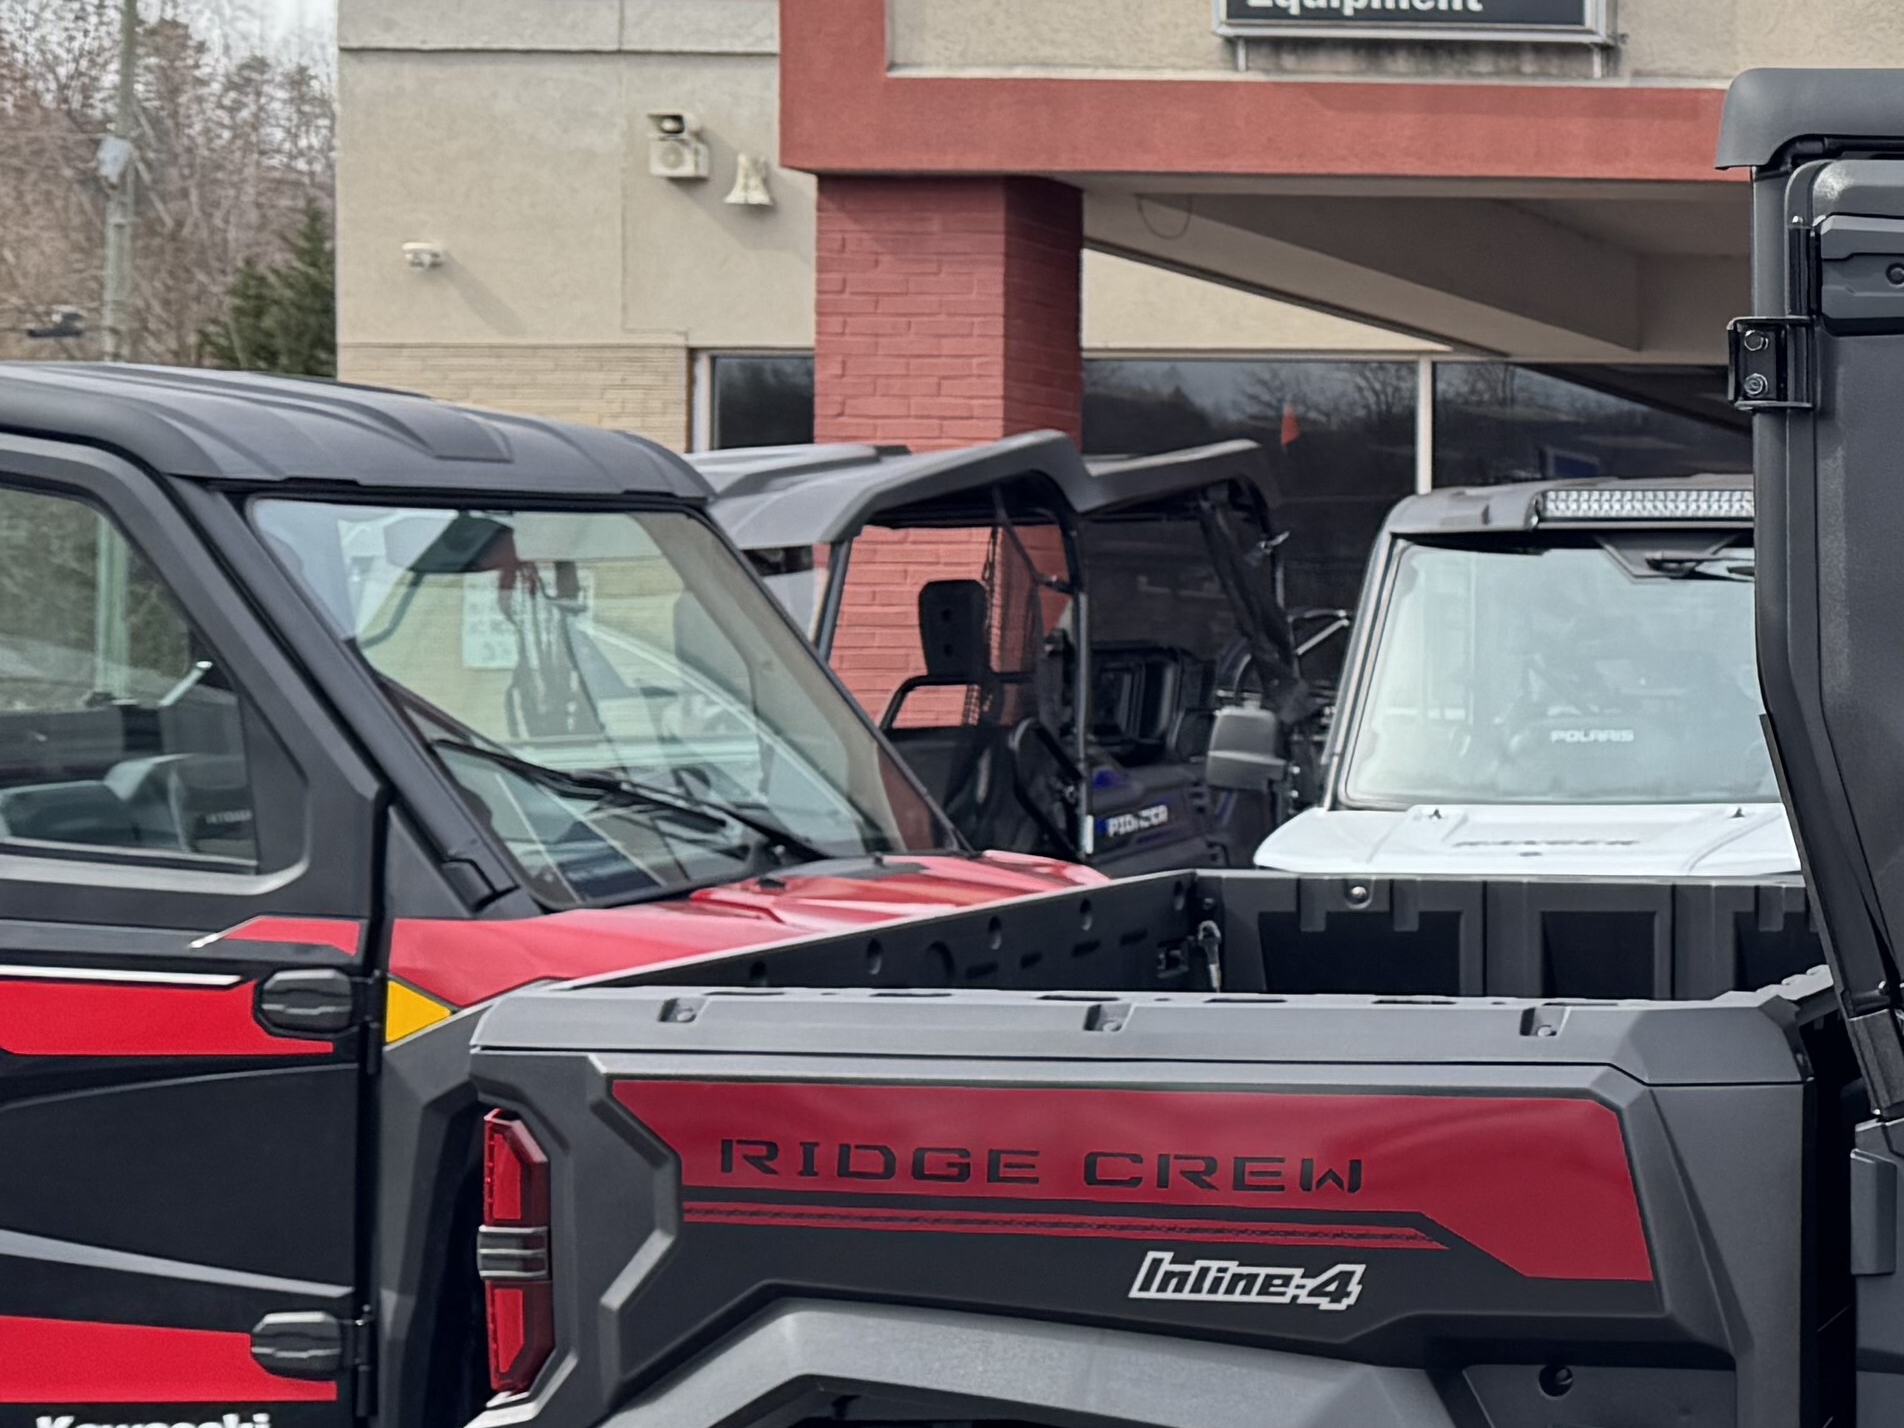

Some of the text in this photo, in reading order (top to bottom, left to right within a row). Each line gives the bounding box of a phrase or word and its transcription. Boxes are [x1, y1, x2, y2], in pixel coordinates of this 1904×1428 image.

[1551, 729, 1635, 743] POLARIS
[720, 1138, 1362, 1194] RIDGE CREW
